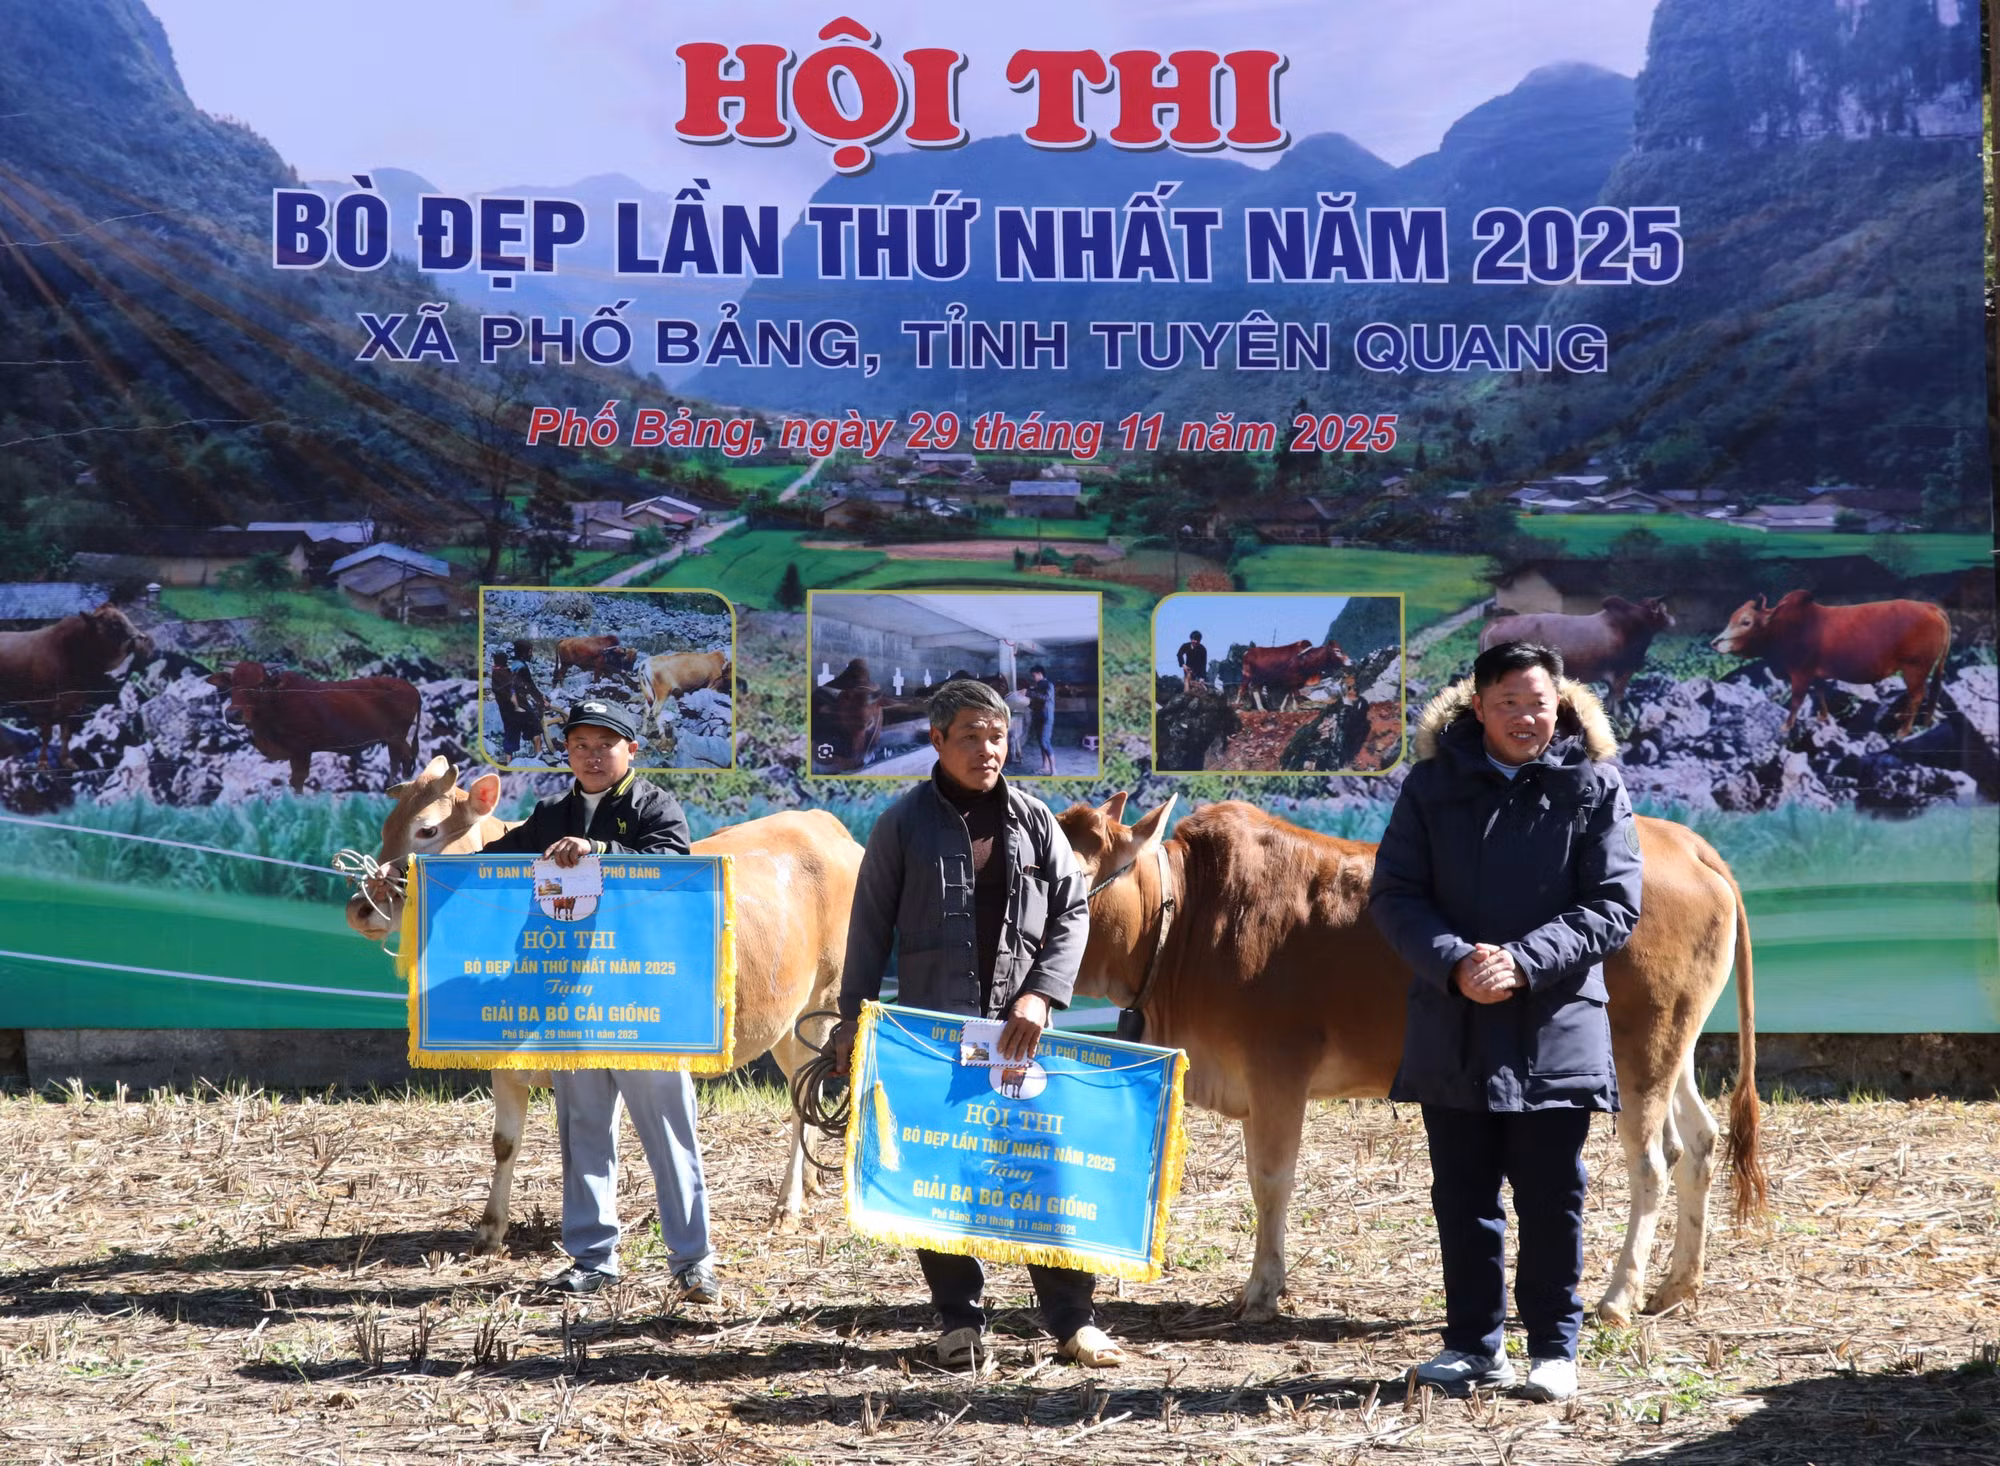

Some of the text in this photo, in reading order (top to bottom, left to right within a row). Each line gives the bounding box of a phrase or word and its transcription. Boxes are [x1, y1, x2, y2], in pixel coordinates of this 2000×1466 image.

[673, 15, 1290, 176] HỘI THI
[273, 173, 1684, 292] BÒ ĐẸP LẦN THỨ NHẤT NĂM 2025
[355, 298, 1609, 378] XÃ PHỐ BẢNG, TỈNH TUYÊN QUANG
[526, 399, 1399, 460] Phố Bảng, ngày 29 tháng 11 năm 2025
[496, 866, 520, 879] BAN
[522, 925, 616, 954] HỘI THI
[464, 955, 676, 977] BÒ ĐẸP LẦN THỨ NHẤT NĂM 2025
[481, 1000, 661, 1023] GIẢI BA BÒ CÁI GIỐNG
[544, 1029, 555, 1039] 29
[585, 1029, 594, 1039] 11
[617, 1029, 638, 1040] 2025
[964, 1099, 1065, 1135] HỘI THI
[902, 1125, 1116, 1173] BÒ ĐẸP LẦN THỨ NHẤT NĂM 2025
[913, 1174, 1098, 1221] GIẢI BA BÒ CÁI GIỐNG
[975, 1213, 987, 1225] 29
[1017, 1217, 1029, 1229] 11
[1054, 1223, 1077, 1236] 2025
